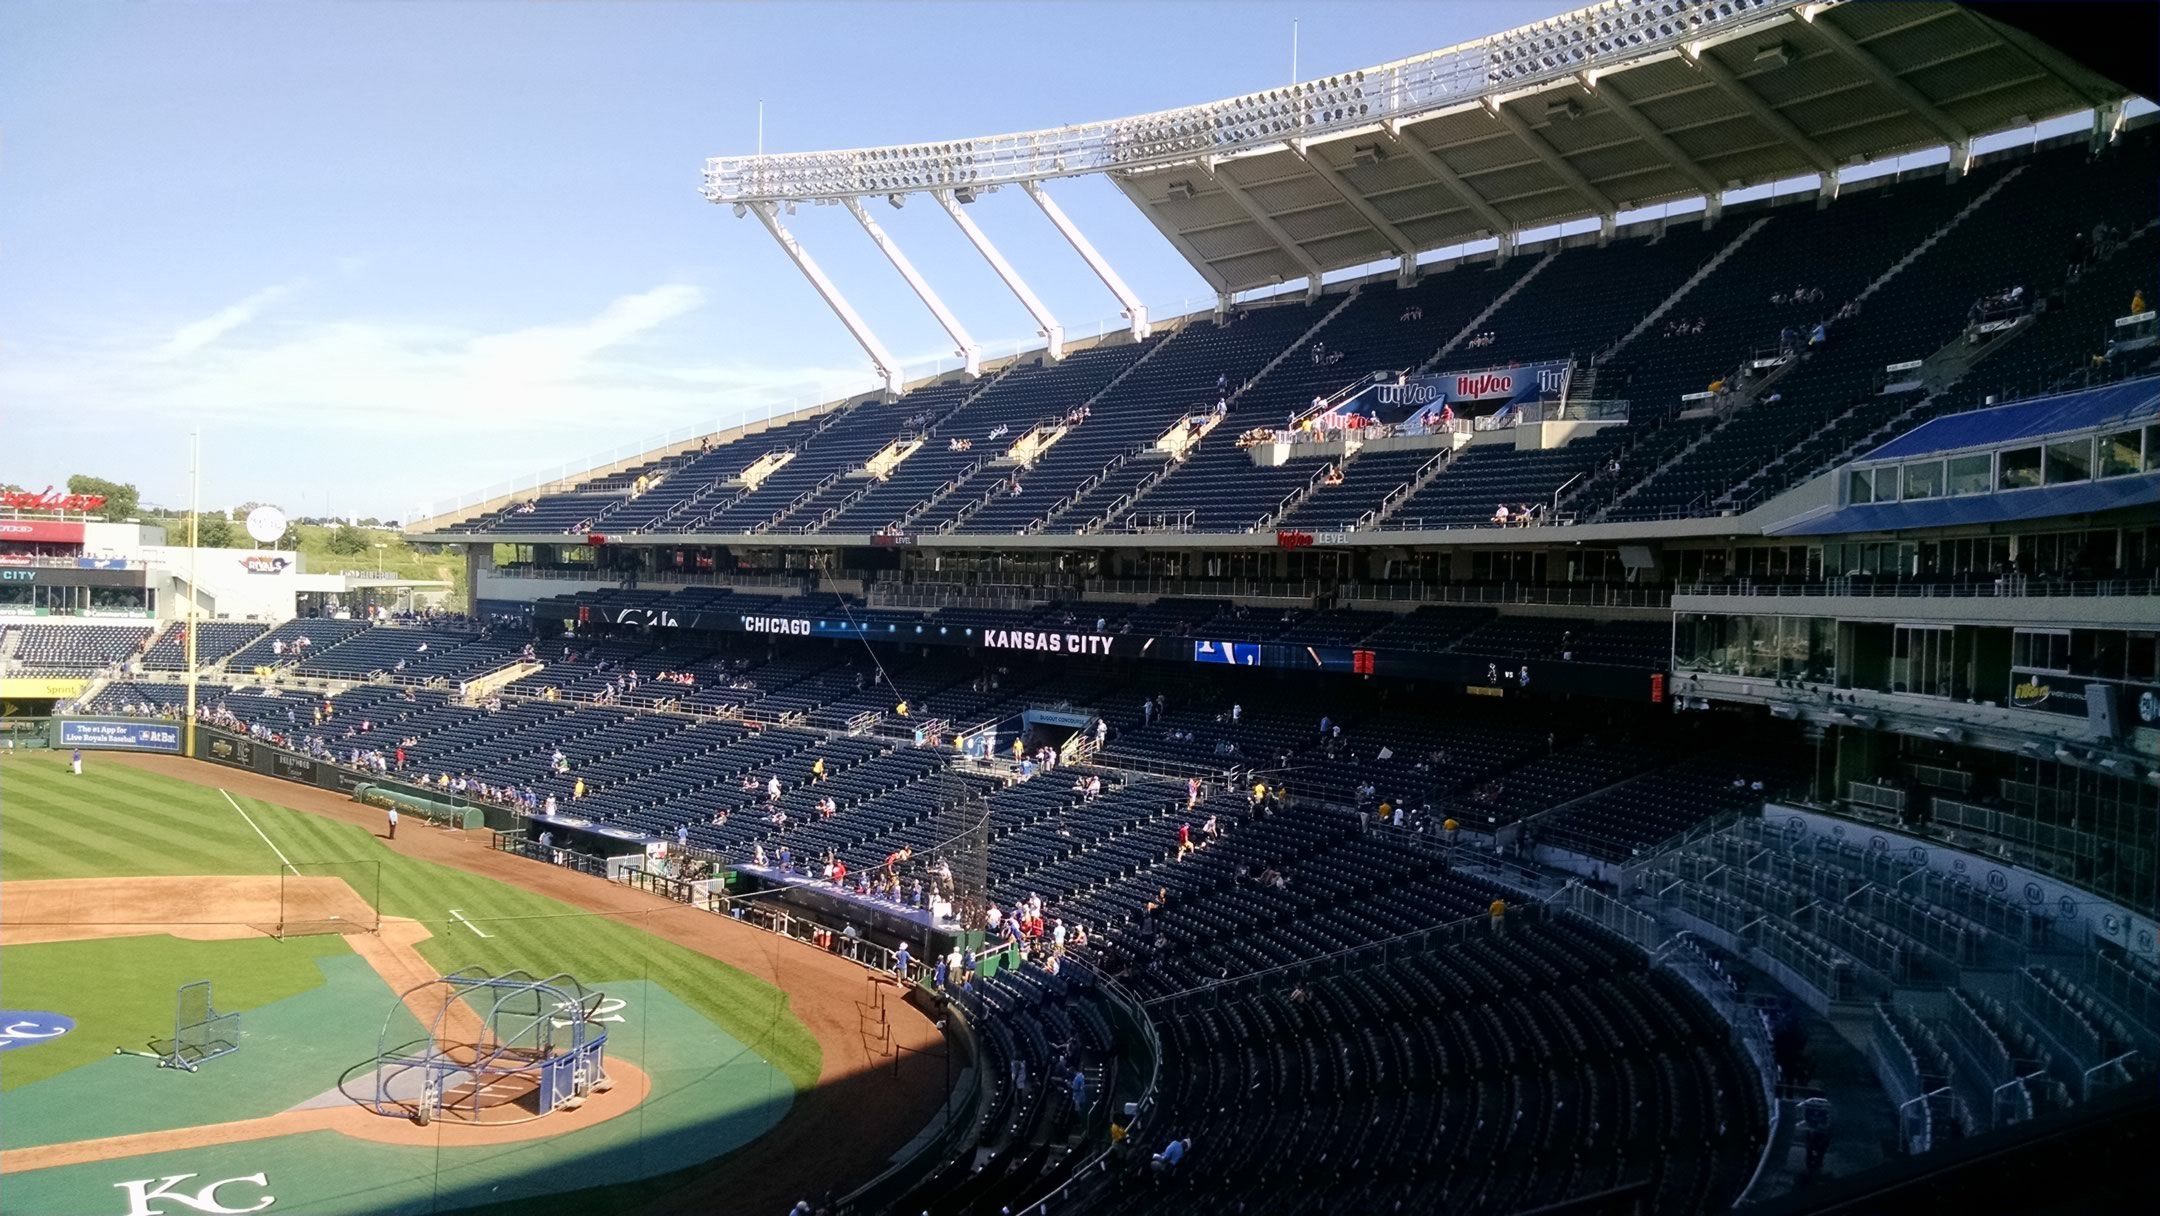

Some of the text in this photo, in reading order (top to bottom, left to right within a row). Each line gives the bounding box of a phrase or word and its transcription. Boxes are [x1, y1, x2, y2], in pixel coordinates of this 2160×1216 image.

[1457, 373, 1513, 399] HyVee
[895, 537, 912, 545] LEVEL
[1319, 533, 1349, 543] LEVEL
[3, 570, 36, 580] CITY
[129, 610, 148, 618] Bank
[745, 616, 811, 636] CHICAGO
[984, 629, 1114, 655] KANSAS CITY
[46, 685, 75, 696] Sprint
[77, 725, 91, 733] The
[101, 726, 116, 735] App
[83, 734, 107, 743] Royals
[109, 735, 136, 743] Baseball
[150, 731, 176, 743] At Bat
[114, 1173, 276, 1216] KC
